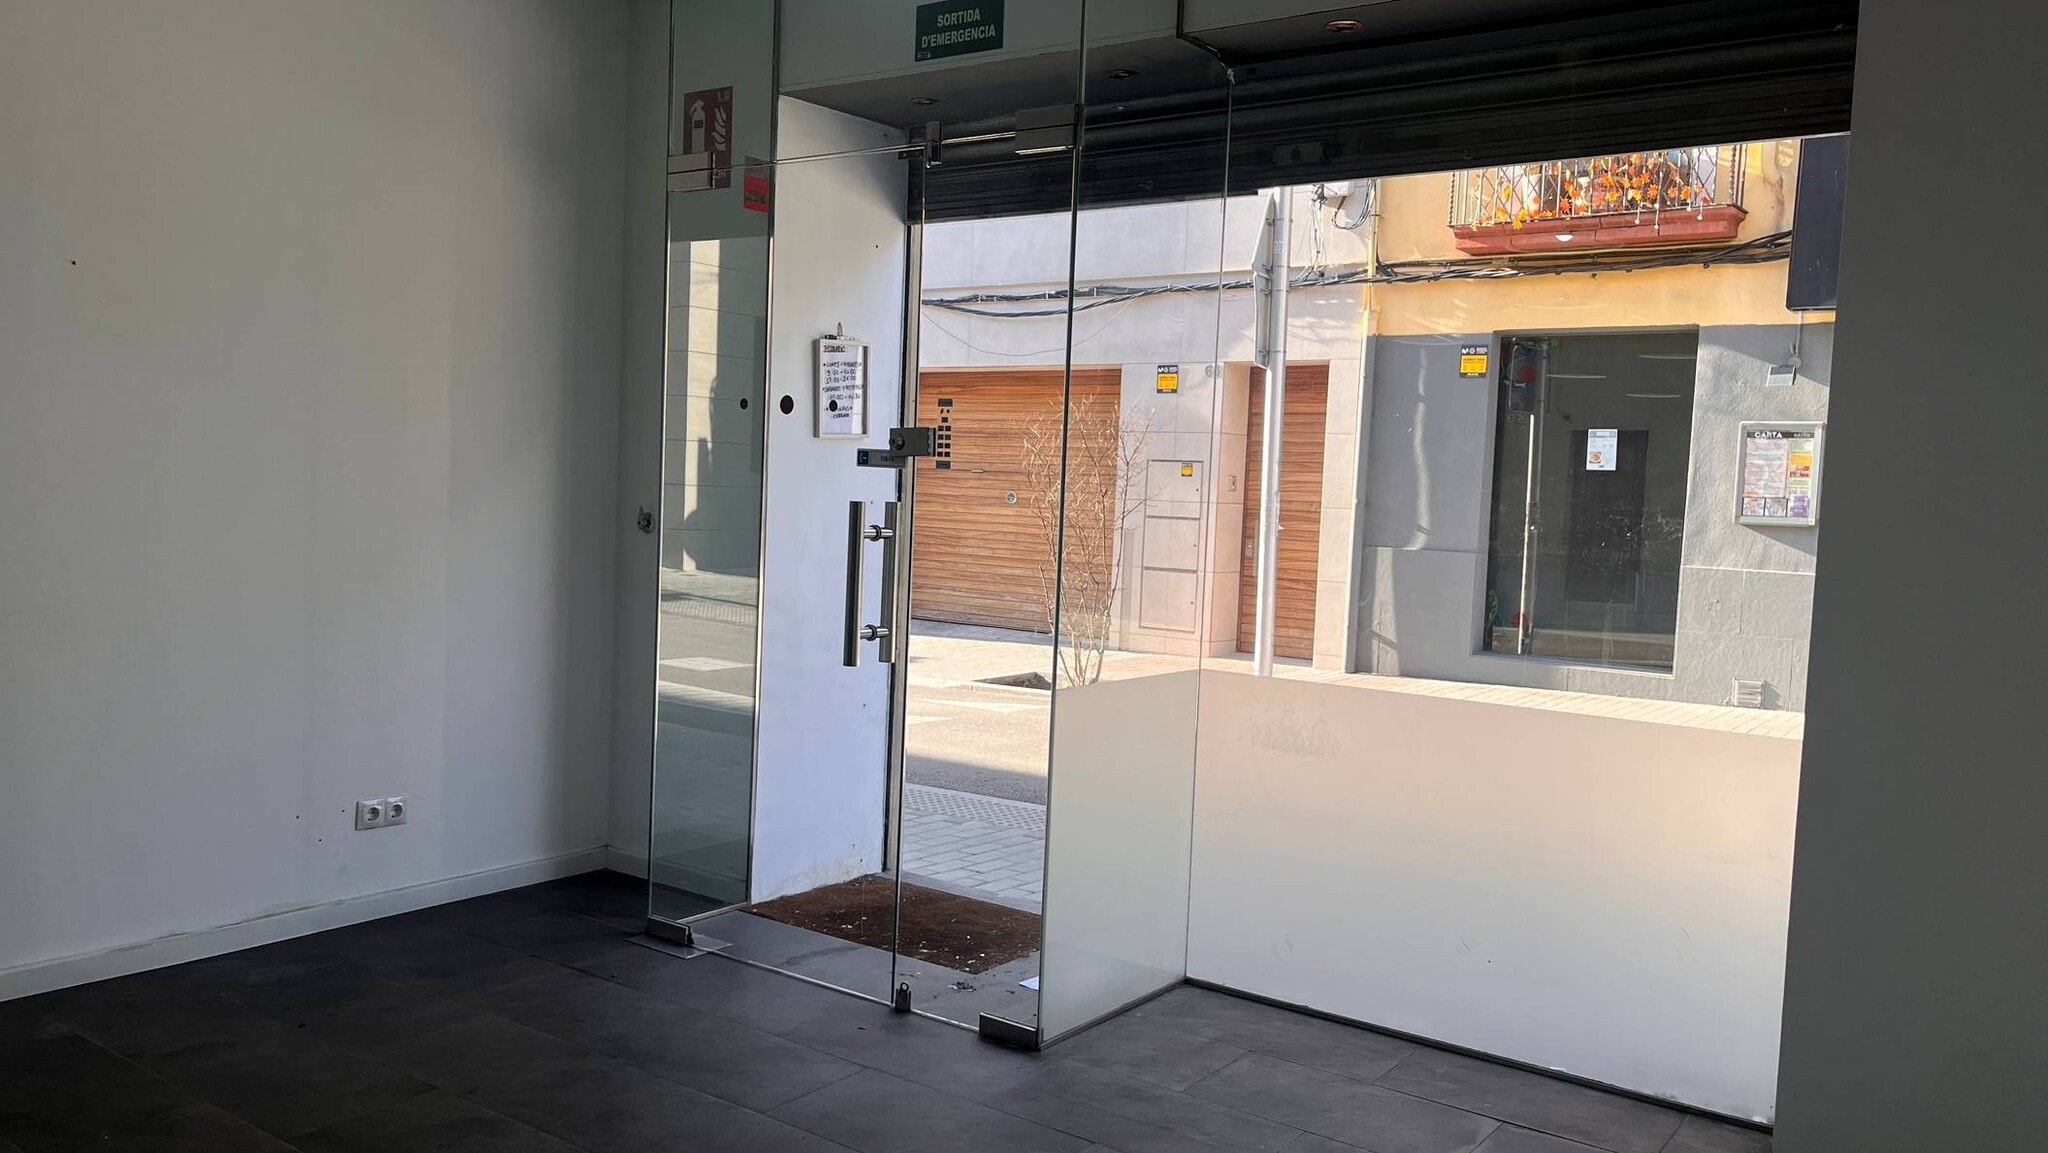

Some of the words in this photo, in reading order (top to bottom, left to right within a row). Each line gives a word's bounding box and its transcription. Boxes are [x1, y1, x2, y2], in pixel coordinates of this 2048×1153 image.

[937, 8, 980, 27] SORTIDA
[921, 24, 996, 48] D'EMERGENCIA
[1754, 431, 1783, 439] CARTA
